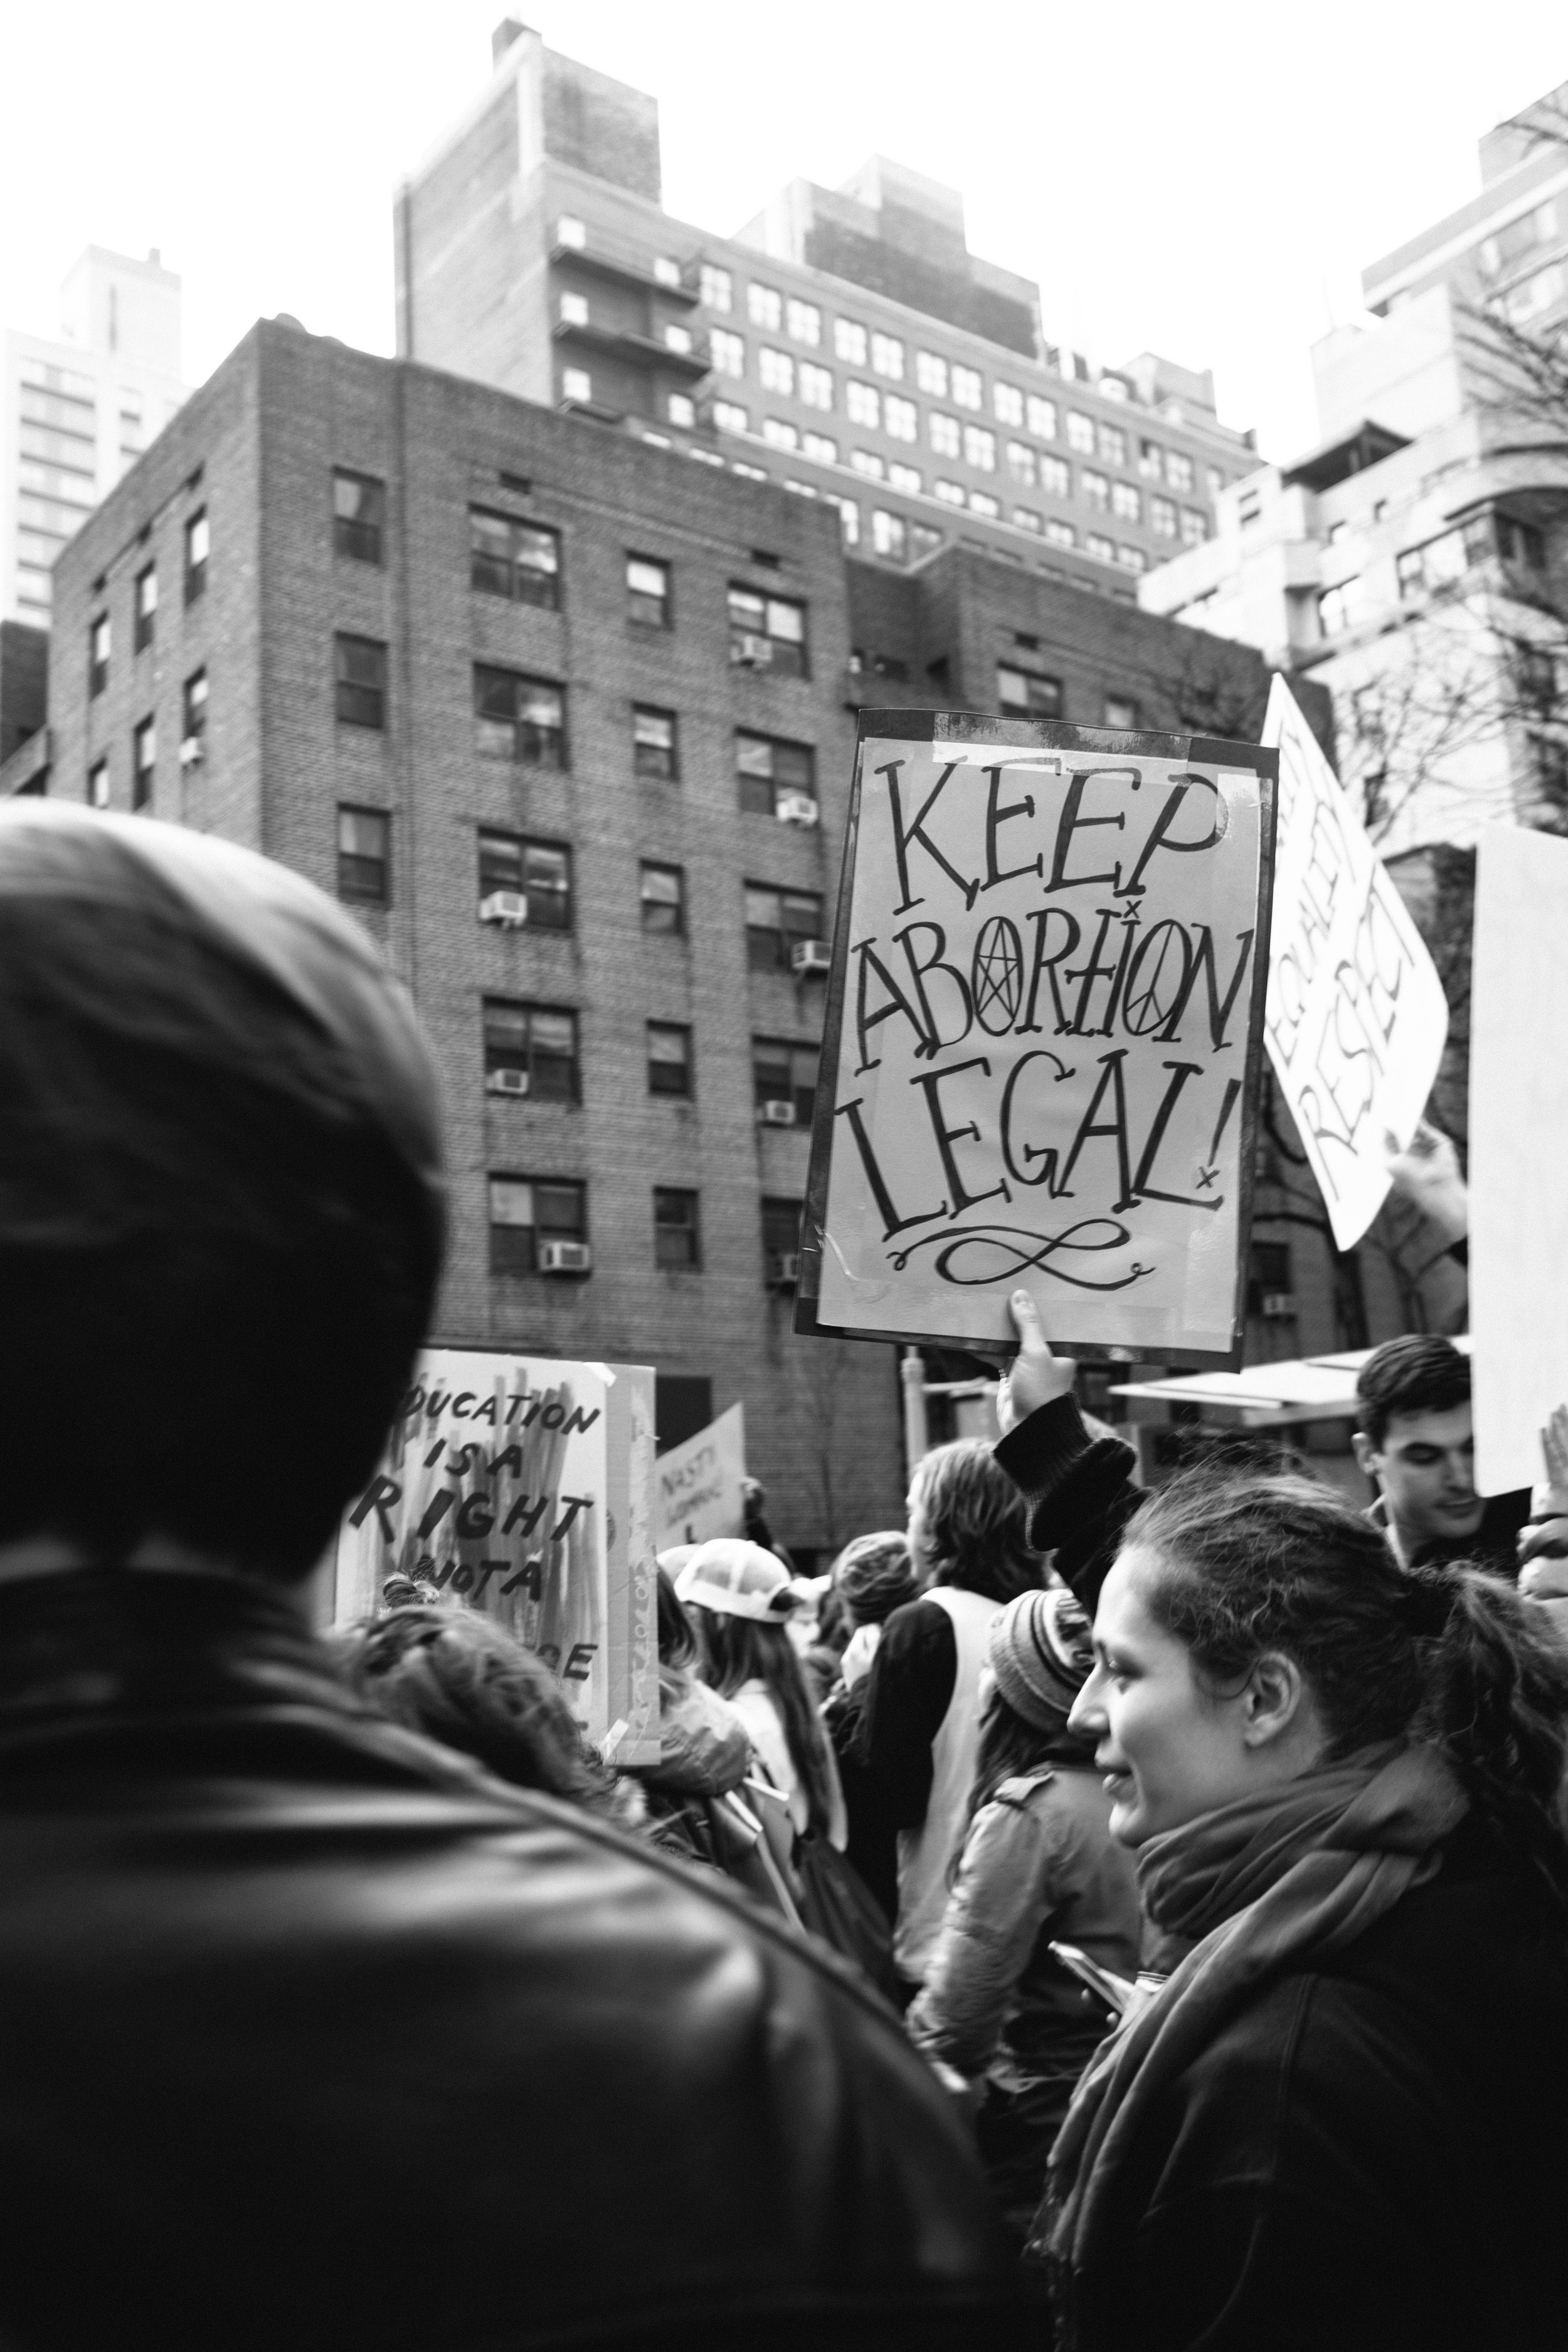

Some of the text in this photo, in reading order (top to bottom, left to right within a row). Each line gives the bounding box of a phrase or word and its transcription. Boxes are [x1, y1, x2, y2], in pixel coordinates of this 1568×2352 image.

[874, 755, 1229, 914] KEEP
[850, 901, 1255, 1077] ABORTION
[834, 1048, 1241, 1241] LEGAL!
[396, 1384, 601, 1435] DUCATION
[422, 1438, 523, 1479] IS A
[348, 1474, 595, 1544] RIGHT
[499, 1560, 542, 1602] A
